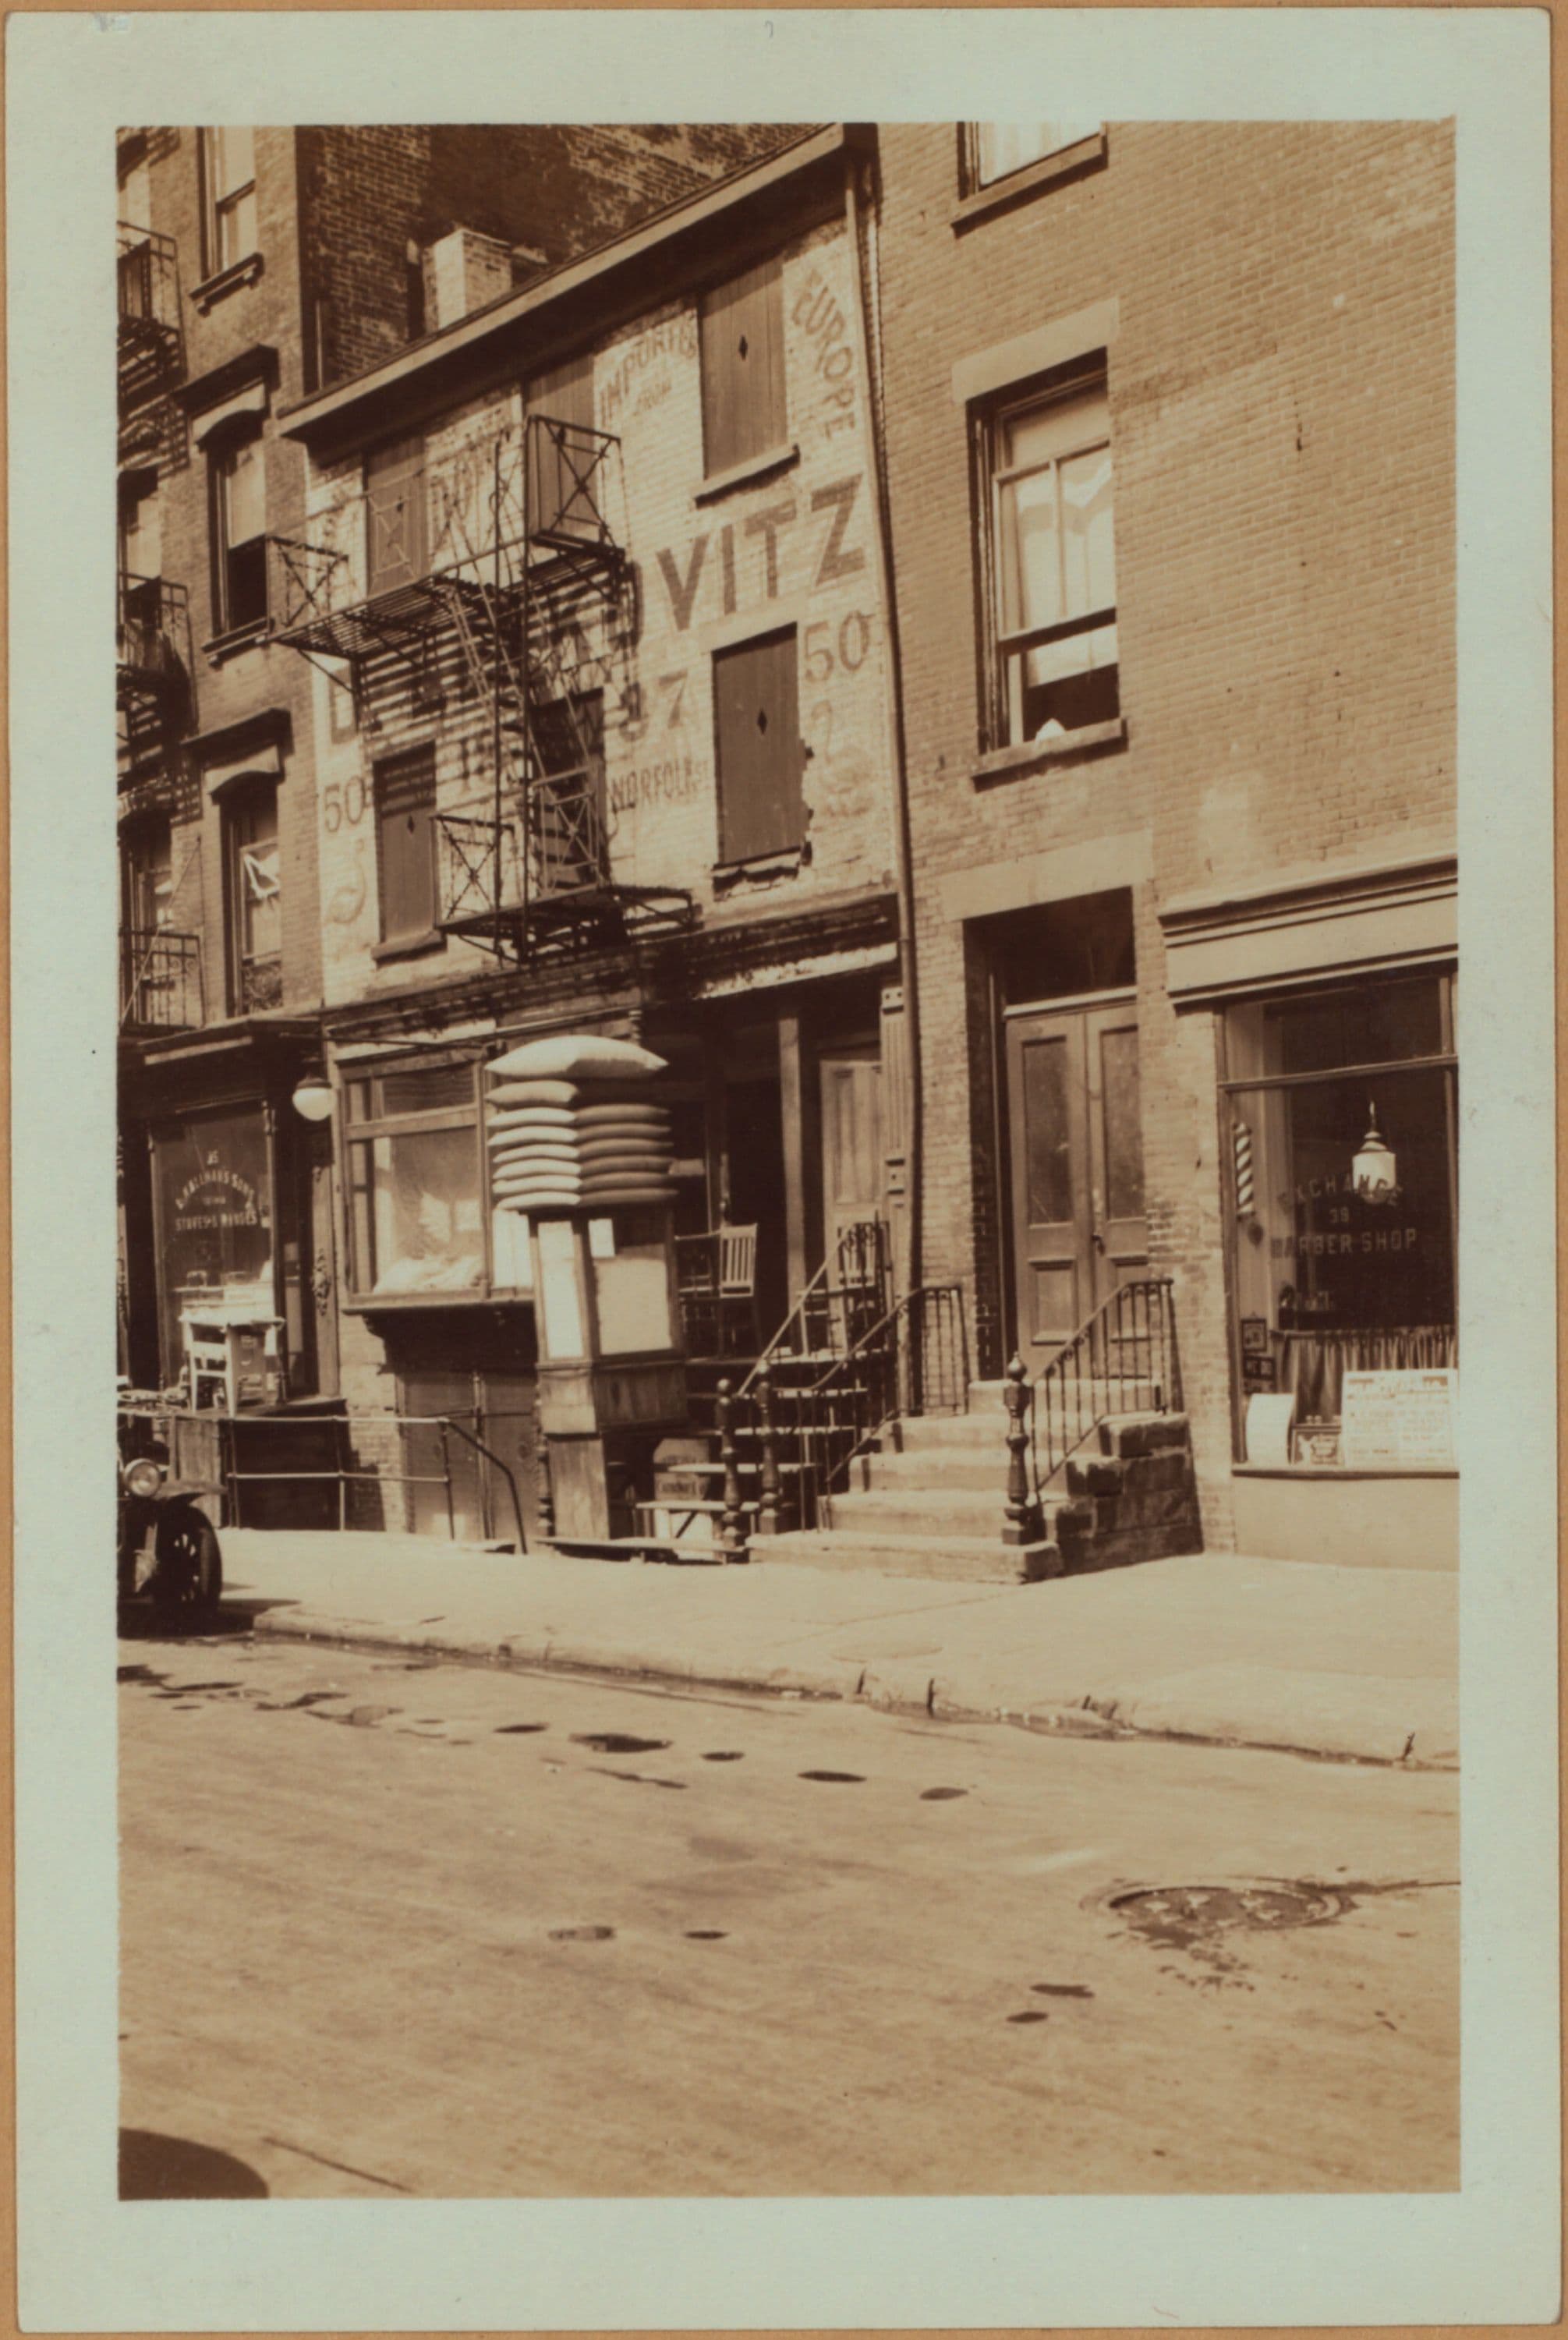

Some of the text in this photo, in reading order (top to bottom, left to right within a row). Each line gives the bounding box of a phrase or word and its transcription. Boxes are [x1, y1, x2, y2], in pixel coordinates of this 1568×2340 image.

[791, 267, 855, 441] EUROPE
[805, 611, 871, 683] 50
[324, 775, 366, 834] 50
[1271, 1228, 1417, 1259] BARBER SHOP
